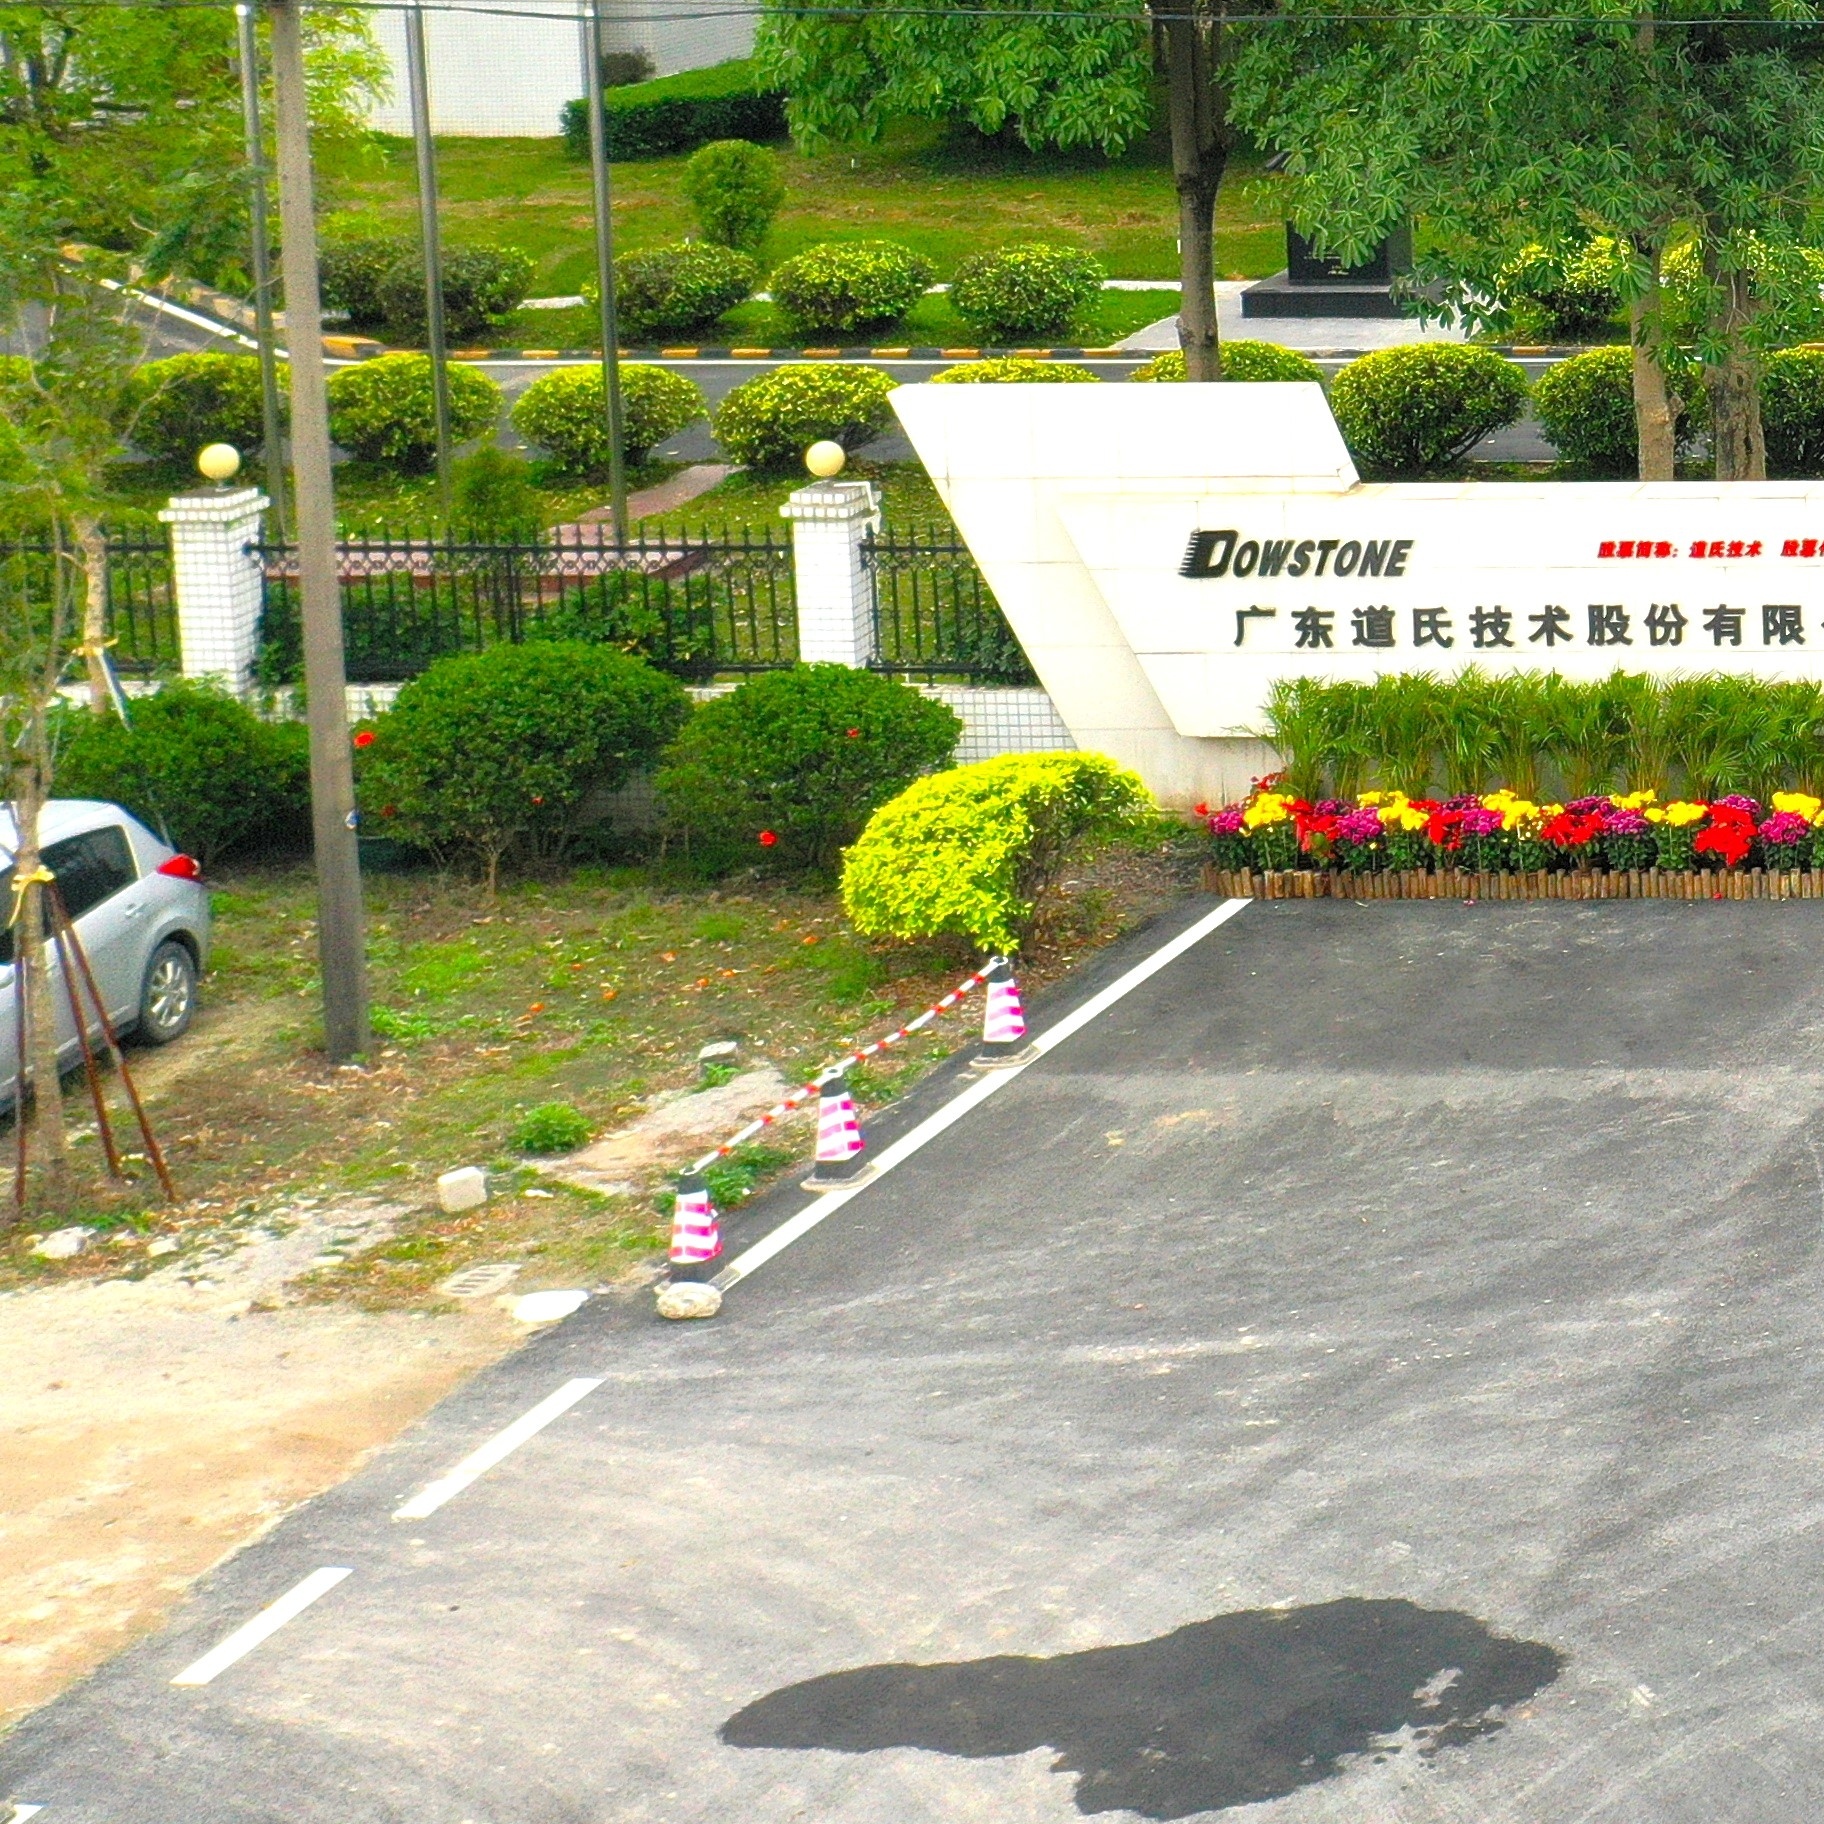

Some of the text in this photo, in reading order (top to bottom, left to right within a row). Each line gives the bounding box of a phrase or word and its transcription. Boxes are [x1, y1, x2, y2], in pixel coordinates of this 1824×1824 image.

[1179, 529, 1414, 580] DOWSTONE
[1688, 540, 1764, 559] 道氏技术
